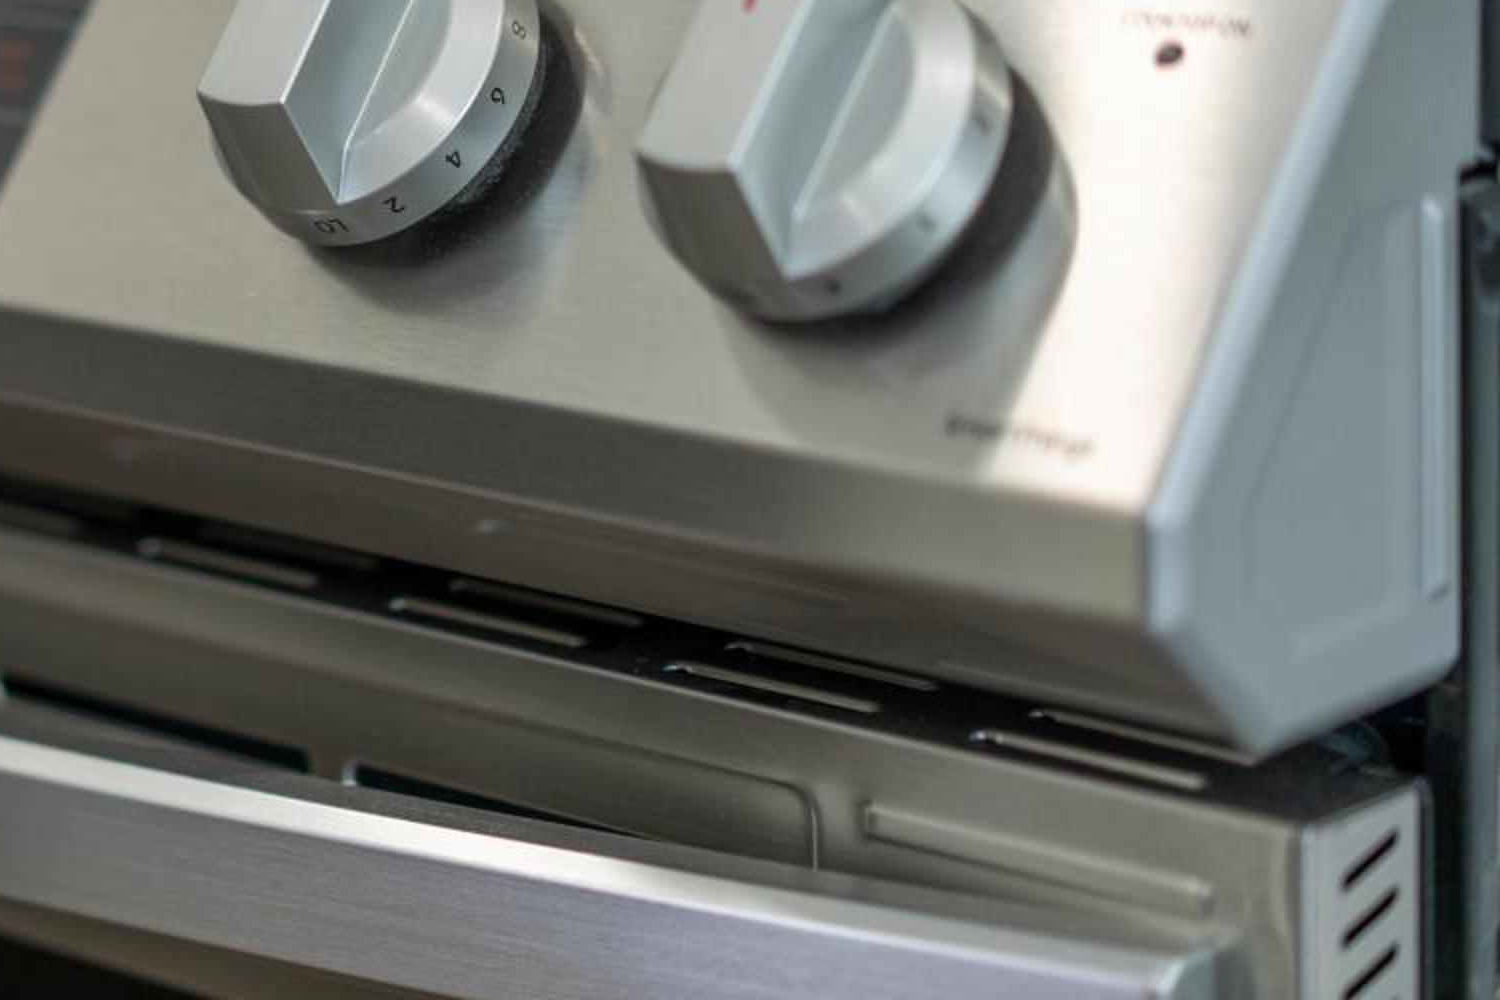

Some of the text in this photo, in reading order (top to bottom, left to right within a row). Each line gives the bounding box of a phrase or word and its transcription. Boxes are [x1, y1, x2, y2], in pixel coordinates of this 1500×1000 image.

[511, 19, 527, 40] 8
[490, 86, 506, 106] 6
[445, 150, 462, 169] 4
[381, 195, 406, 213] 2
